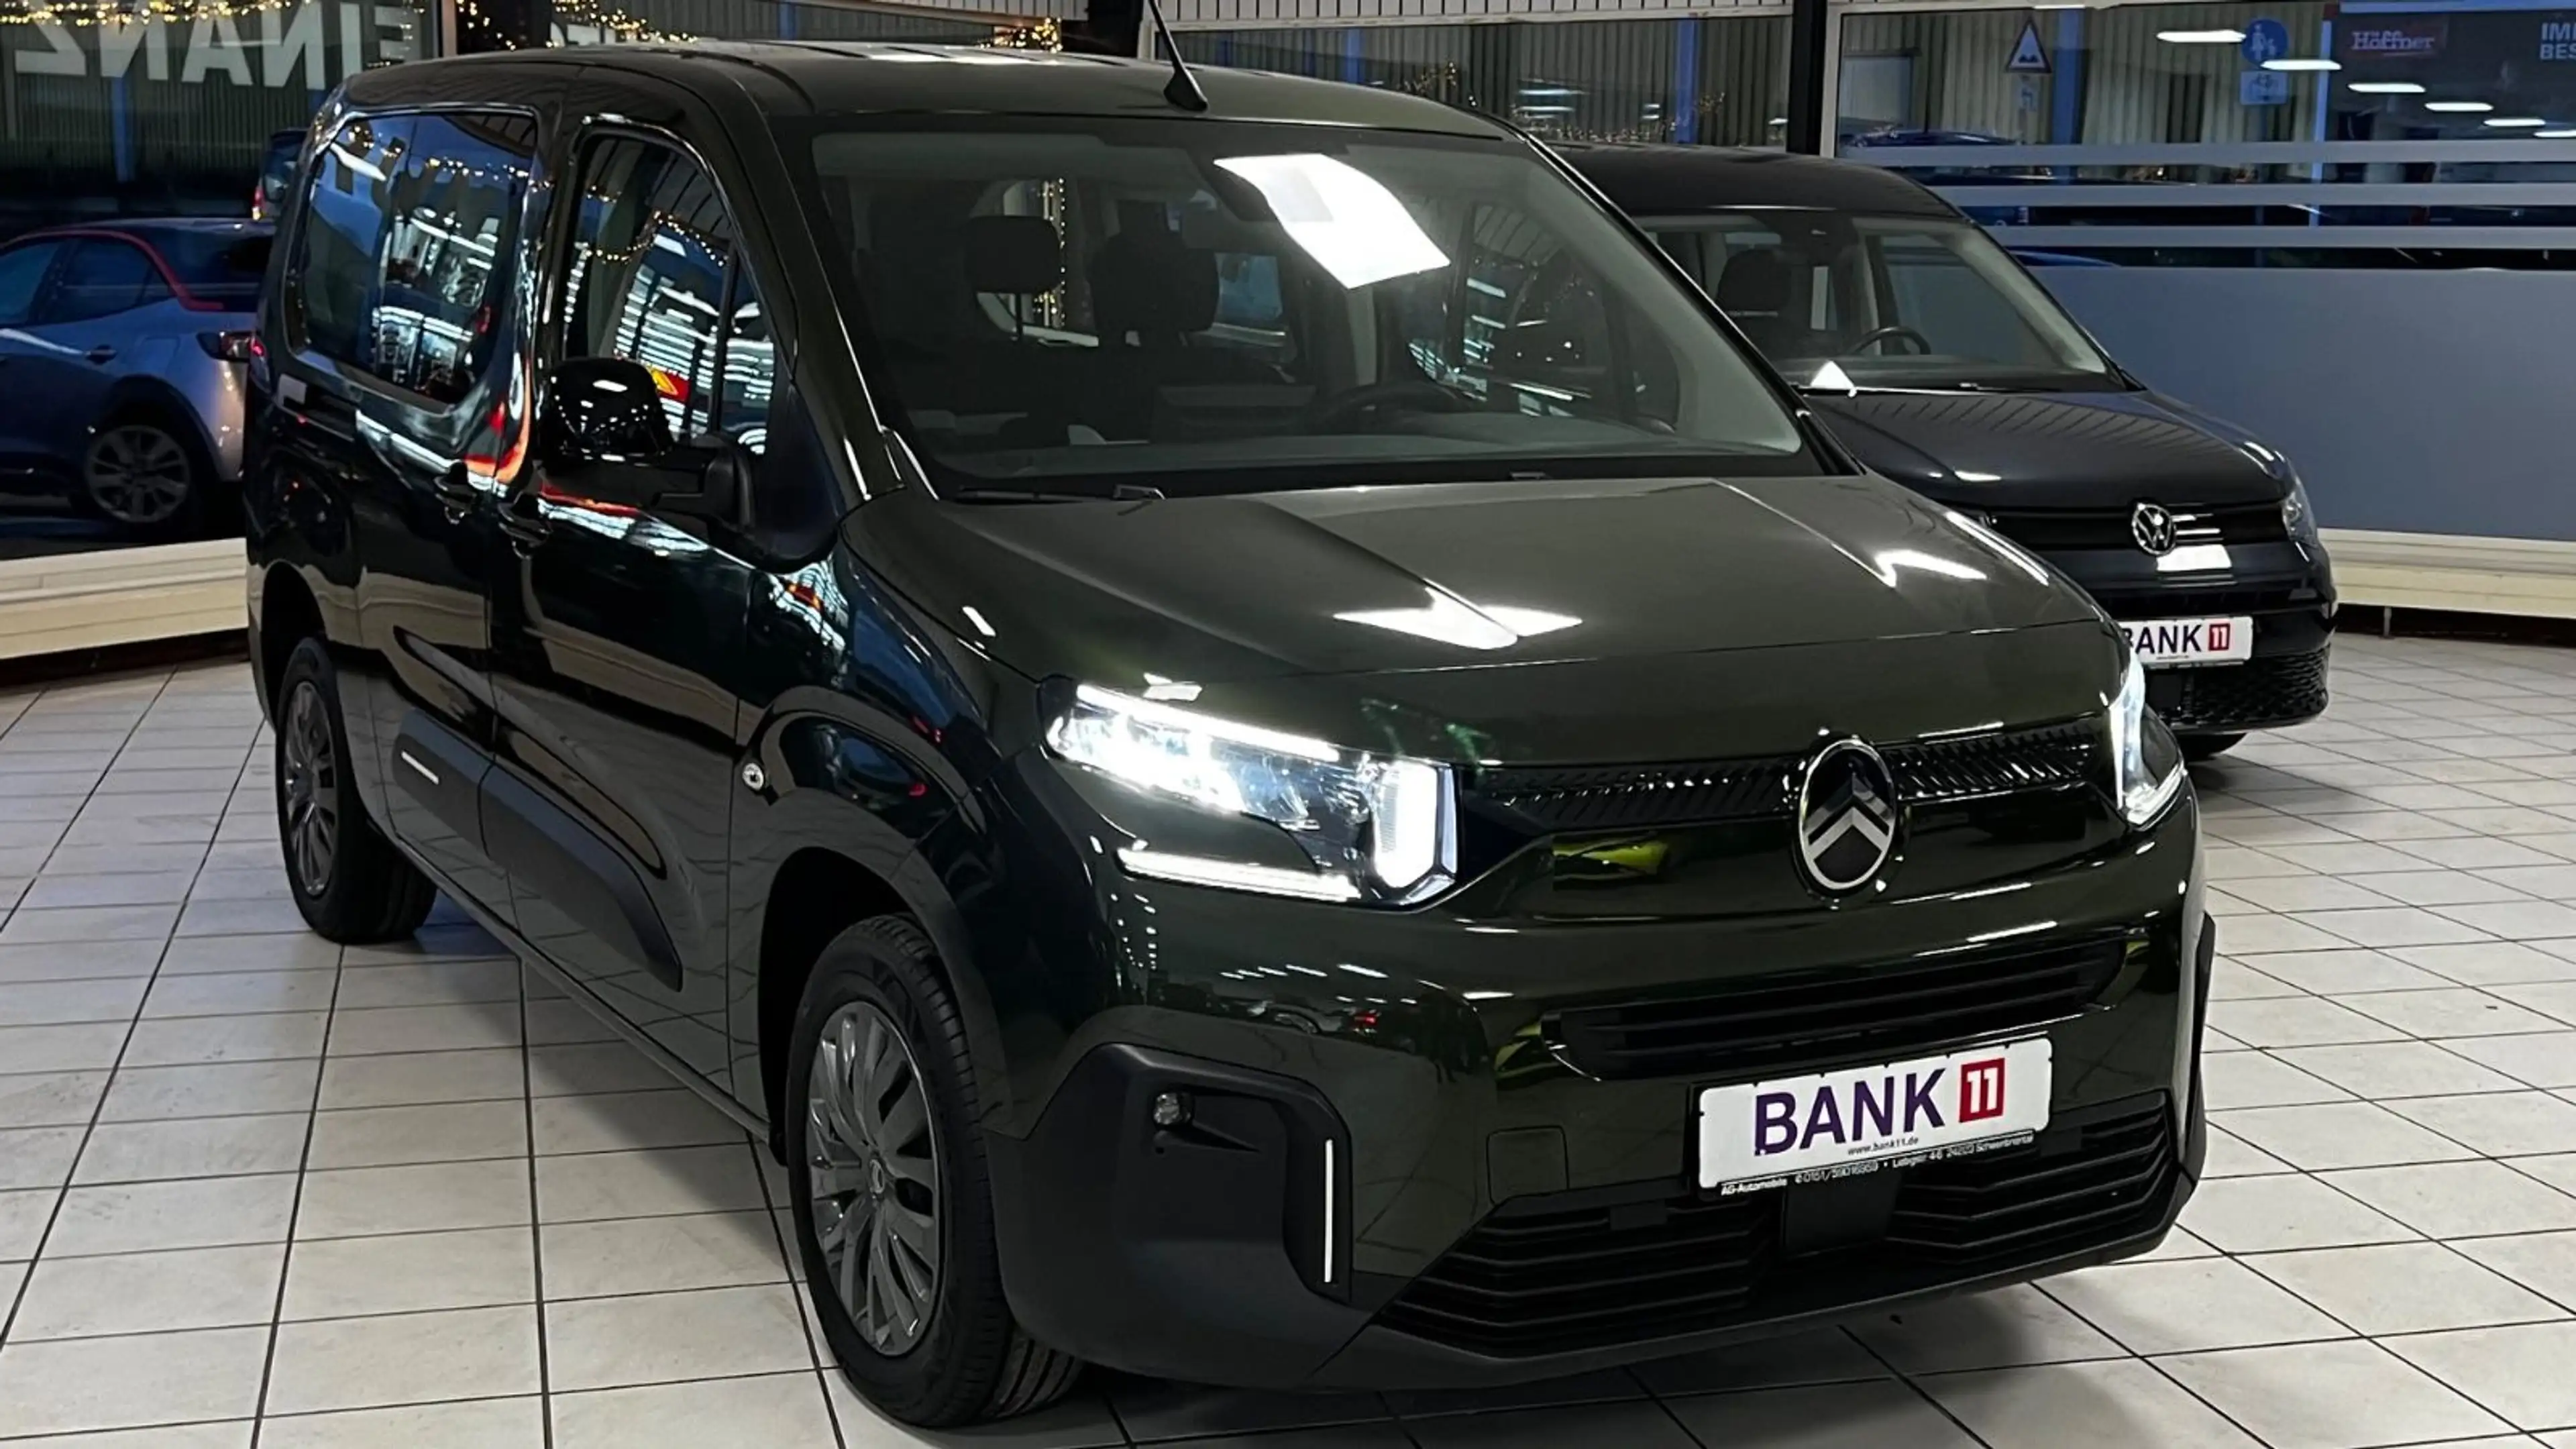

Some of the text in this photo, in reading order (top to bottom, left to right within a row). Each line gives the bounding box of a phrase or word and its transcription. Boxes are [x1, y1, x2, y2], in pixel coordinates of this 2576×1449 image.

[2352, 30, 2434, 50] Höffner
[2541, 23, 2576, 40] IM
[1754, 1067, 1945, 1156] BANK
[1847, 1136, 1919, 1155] www.bank11.de
